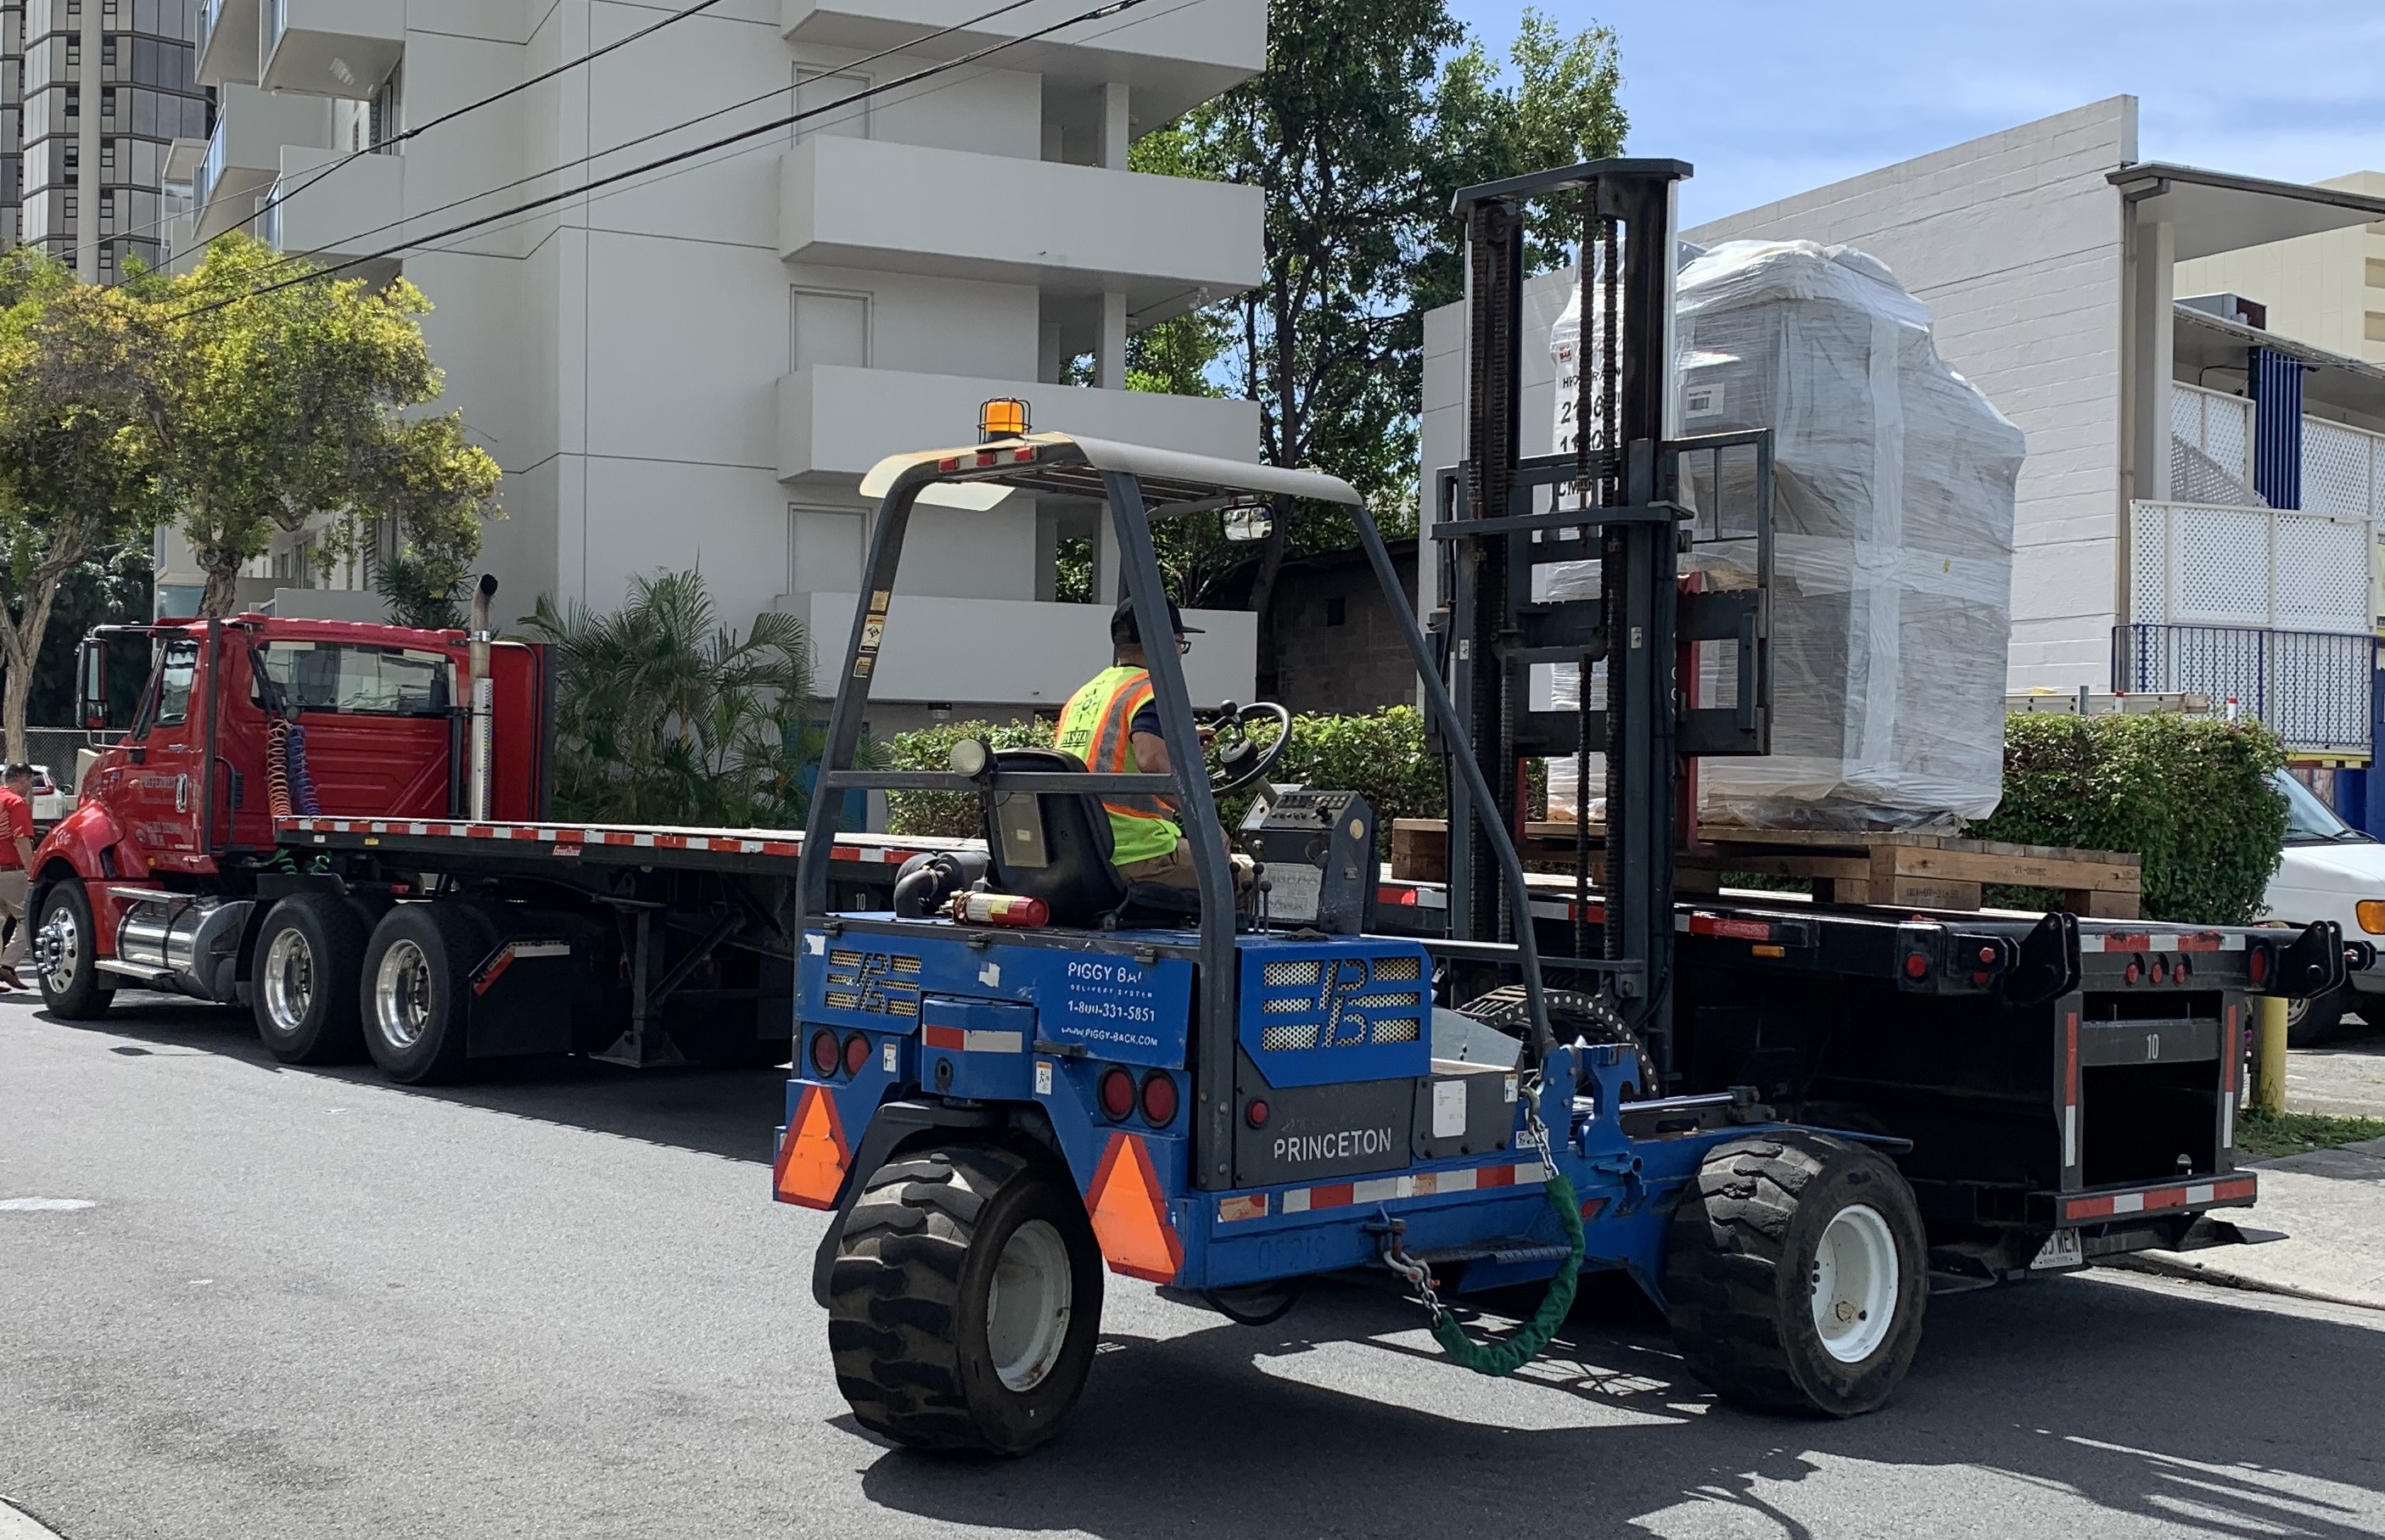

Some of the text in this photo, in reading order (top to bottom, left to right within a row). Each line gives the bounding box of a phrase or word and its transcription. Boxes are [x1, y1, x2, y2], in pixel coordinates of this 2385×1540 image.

[855, 893, 866, 911] 10
[1067, 961, 1112, 981] PIGGY
[2147, 1033, 2159, 1060] 10
[1274, 1127, 1392, 1162] PRINCETON
